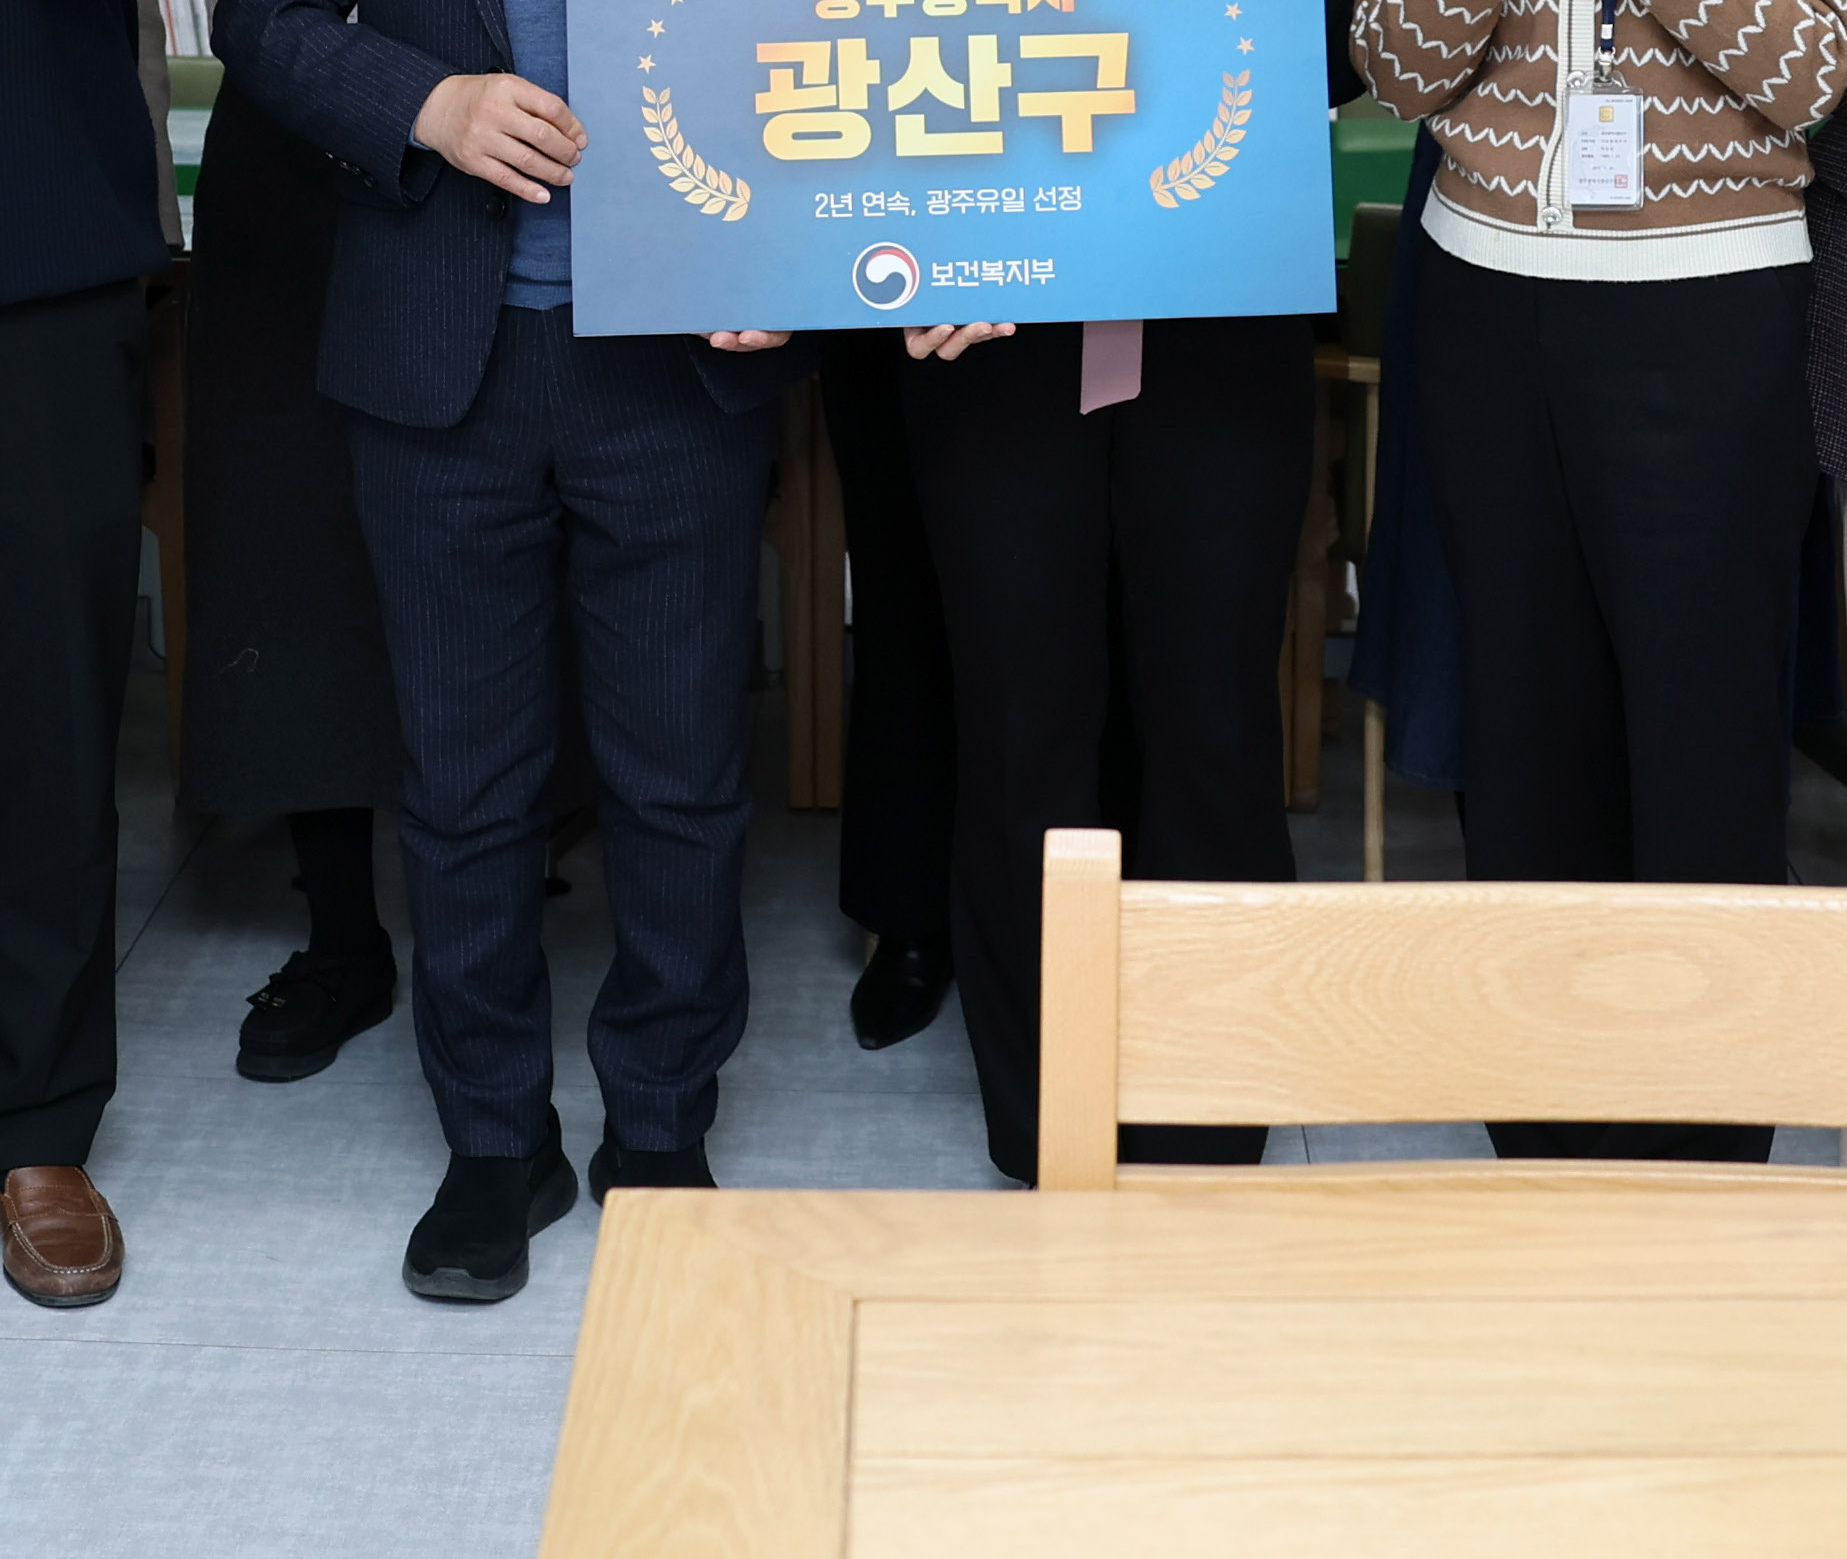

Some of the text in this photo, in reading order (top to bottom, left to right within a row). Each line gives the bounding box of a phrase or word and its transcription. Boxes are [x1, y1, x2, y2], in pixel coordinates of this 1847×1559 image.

[755, 32, 1136, 160] 광산구
[814, 186, 1083, 218] 2년 연속, 광주유일 선정
[930, 258, 1055, 286] 보건복지부
